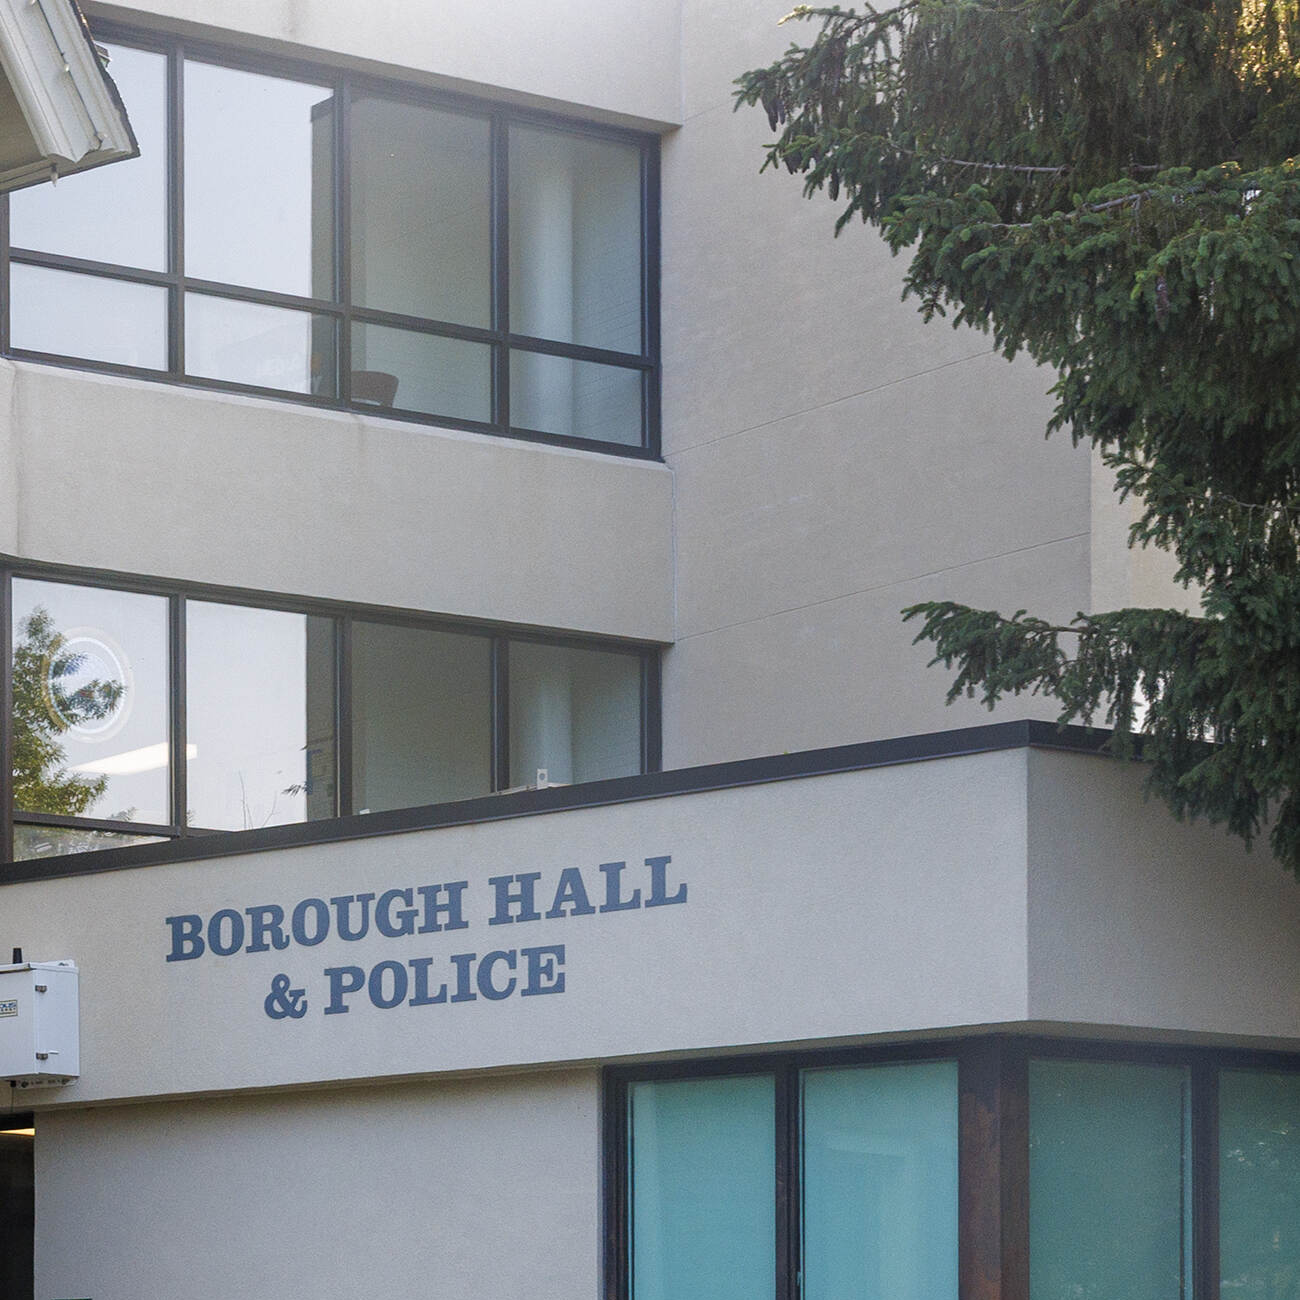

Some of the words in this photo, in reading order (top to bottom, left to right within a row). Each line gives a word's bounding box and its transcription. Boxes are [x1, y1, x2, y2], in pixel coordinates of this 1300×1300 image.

[165, 880, 469, 962] BOROUGH
[487, 855, 688, 926] HALL
[264, 973, 308, 1020] &
[323, 944, 567, 1014] POLICE
